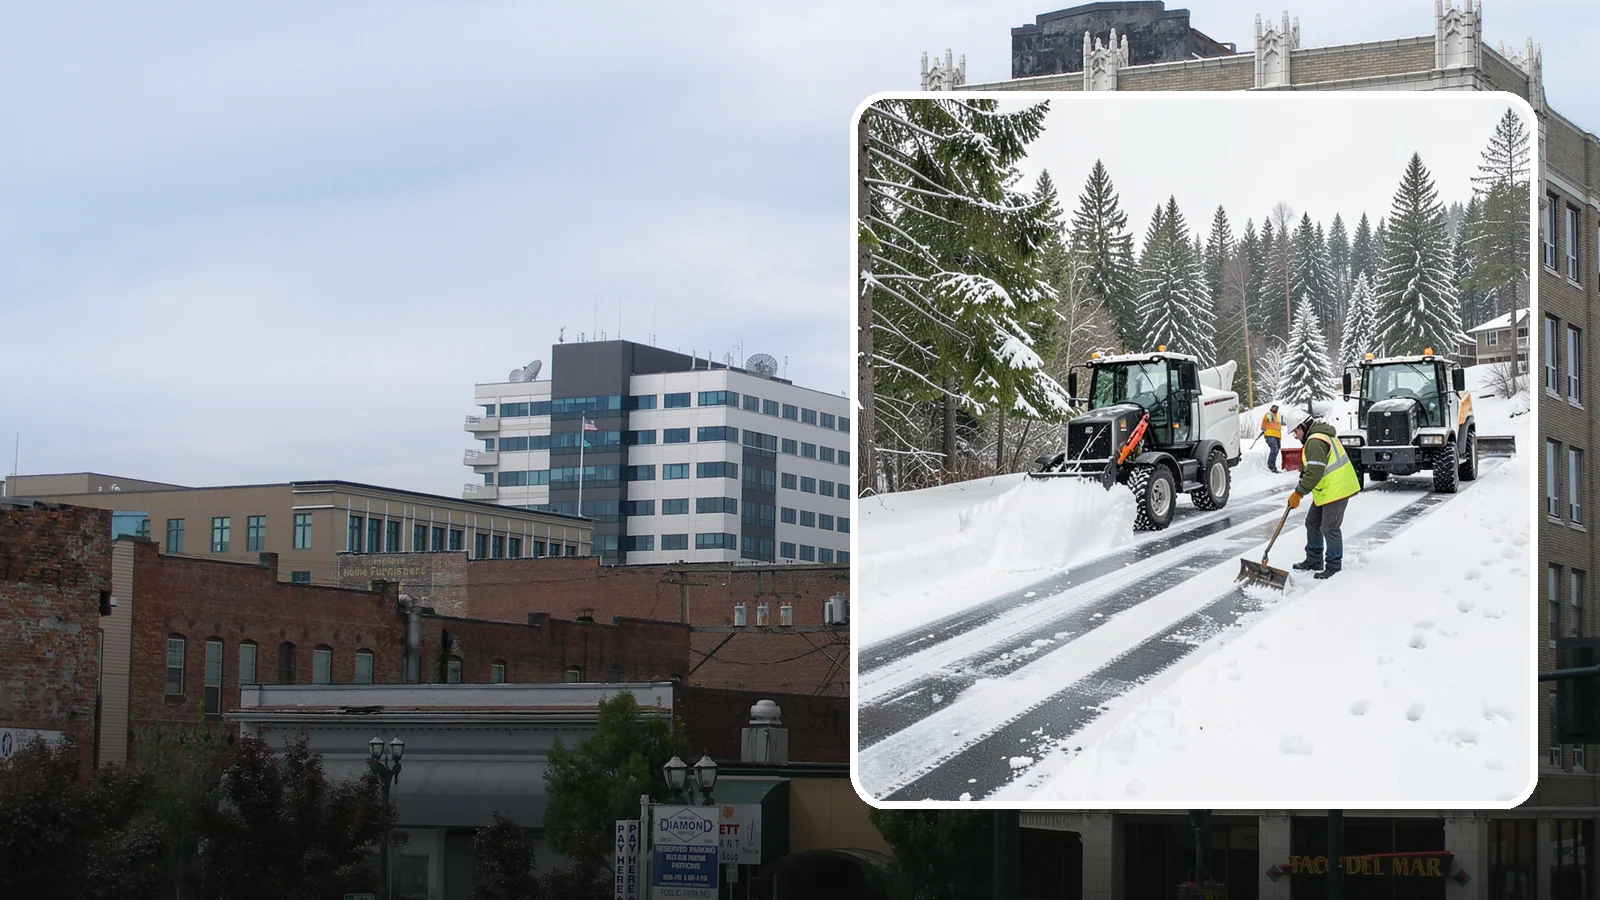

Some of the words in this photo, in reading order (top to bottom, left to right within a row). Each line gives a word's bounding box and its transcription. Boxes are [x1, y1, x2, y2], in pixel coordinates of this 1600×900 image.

[343, 567, 368, 577] Home
[370, 566, 427, 576] Furnishers
[660, 818, 713, 833] DIAMOND
[1022, 815, 1070, 828] BUILDING
[720, 824, 740, 835] ETT
[617, 824, 625, 852] PAY
[628, 824, 637, 852] PAY
[720, 839, 740, 849] ANT
[655, 845, 688, 853] RESERVED
[689, 846, 716, 854] PARKING
[722, 851, 739, 862] Soup
[671, 862, 701, 870] PATRONS
[1289, 855, 1329, 875] TAC
[1346, 856, 1385, 876] DEL
[1392, 857, 1442, 877] MAR
[616, 856, 625, 894] HERE
[627, 856, 636, 893] HERE
[660, 888, 682, 897] PUBLIC
[683, 889, 710, 898] PARKING
